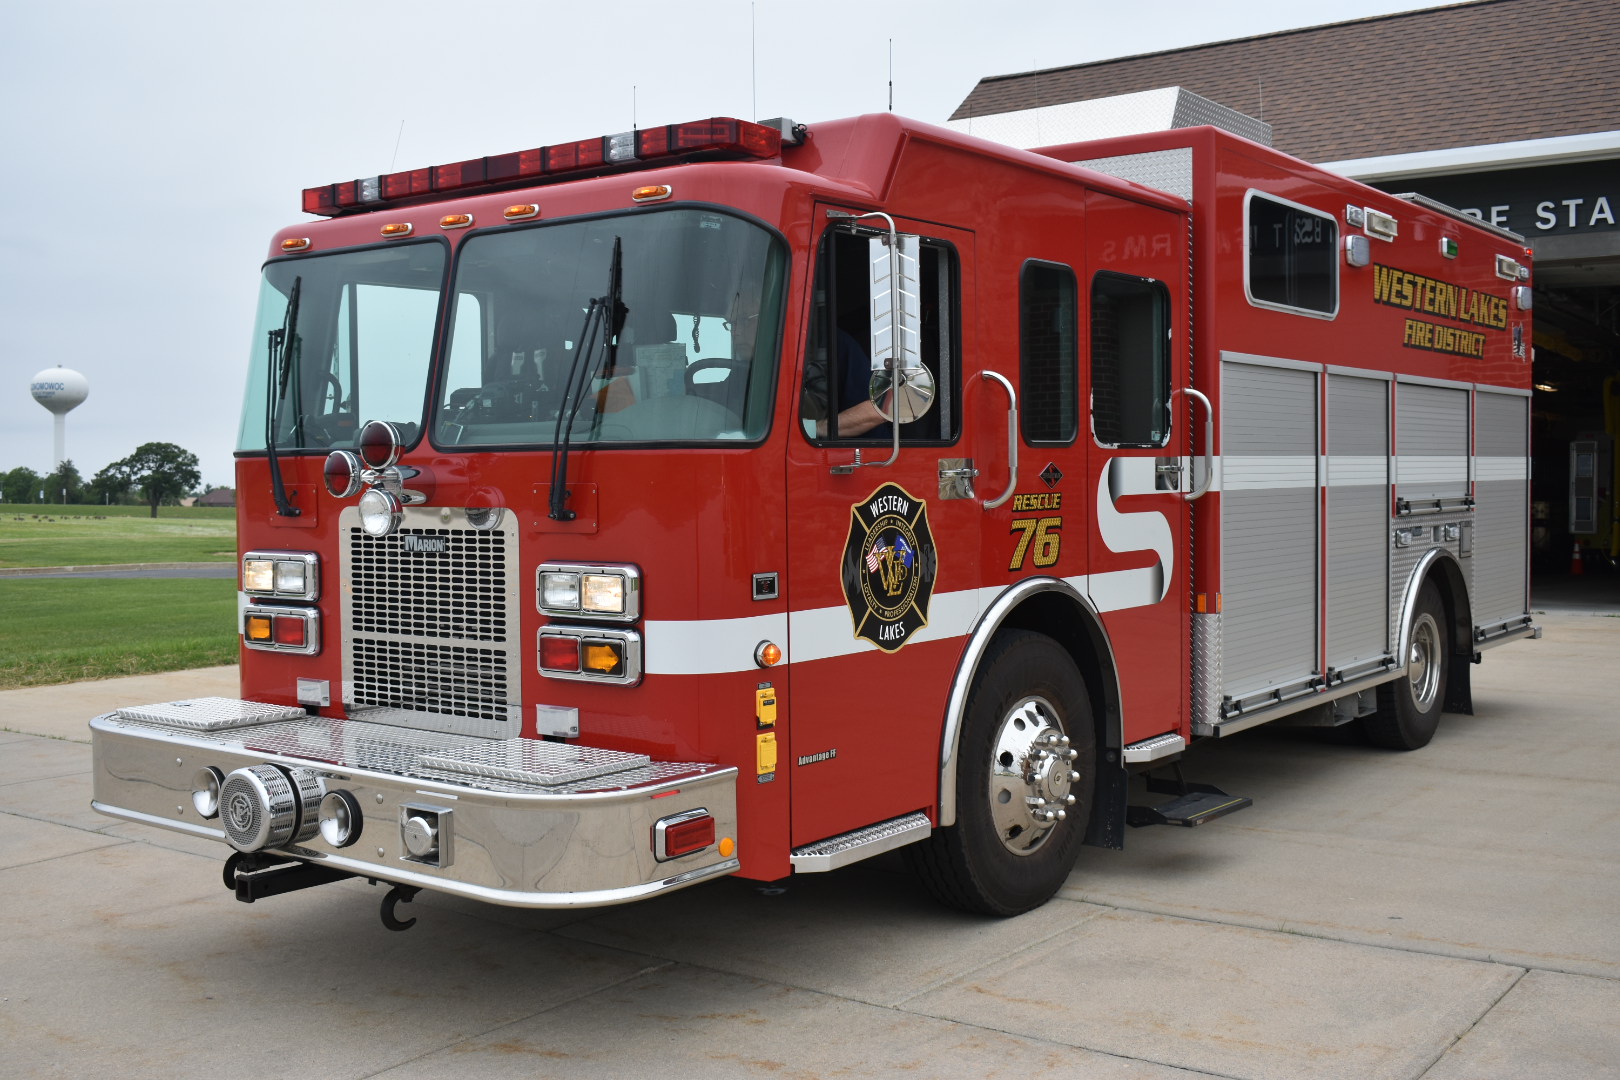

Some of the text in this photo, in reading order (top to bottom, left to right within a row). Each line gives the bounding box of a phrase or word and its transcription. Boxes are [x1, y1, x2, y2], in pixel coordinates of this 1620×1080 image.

[1535, 196, 1615, 230] STA
[1374, 263, 1508, 331] WESTERN LAKES
[1403, 318, 1486, 359] FIRE DISTRICT
[870, 495, 909, 518] WESTERN
[1012, 492, 1062, 512] RESCUE
[865, 519, 889, 551] LEADERSHIP
[895, 520, 916, 546] INTEGRITY
[1008, 516, 1062, 571] 76
[863, 576, 918, 618] LOYALTY PROFESSIONALISM
[879, 621, 905, 641] LAKES
[798, 748, 837, 766] Advantage FF
